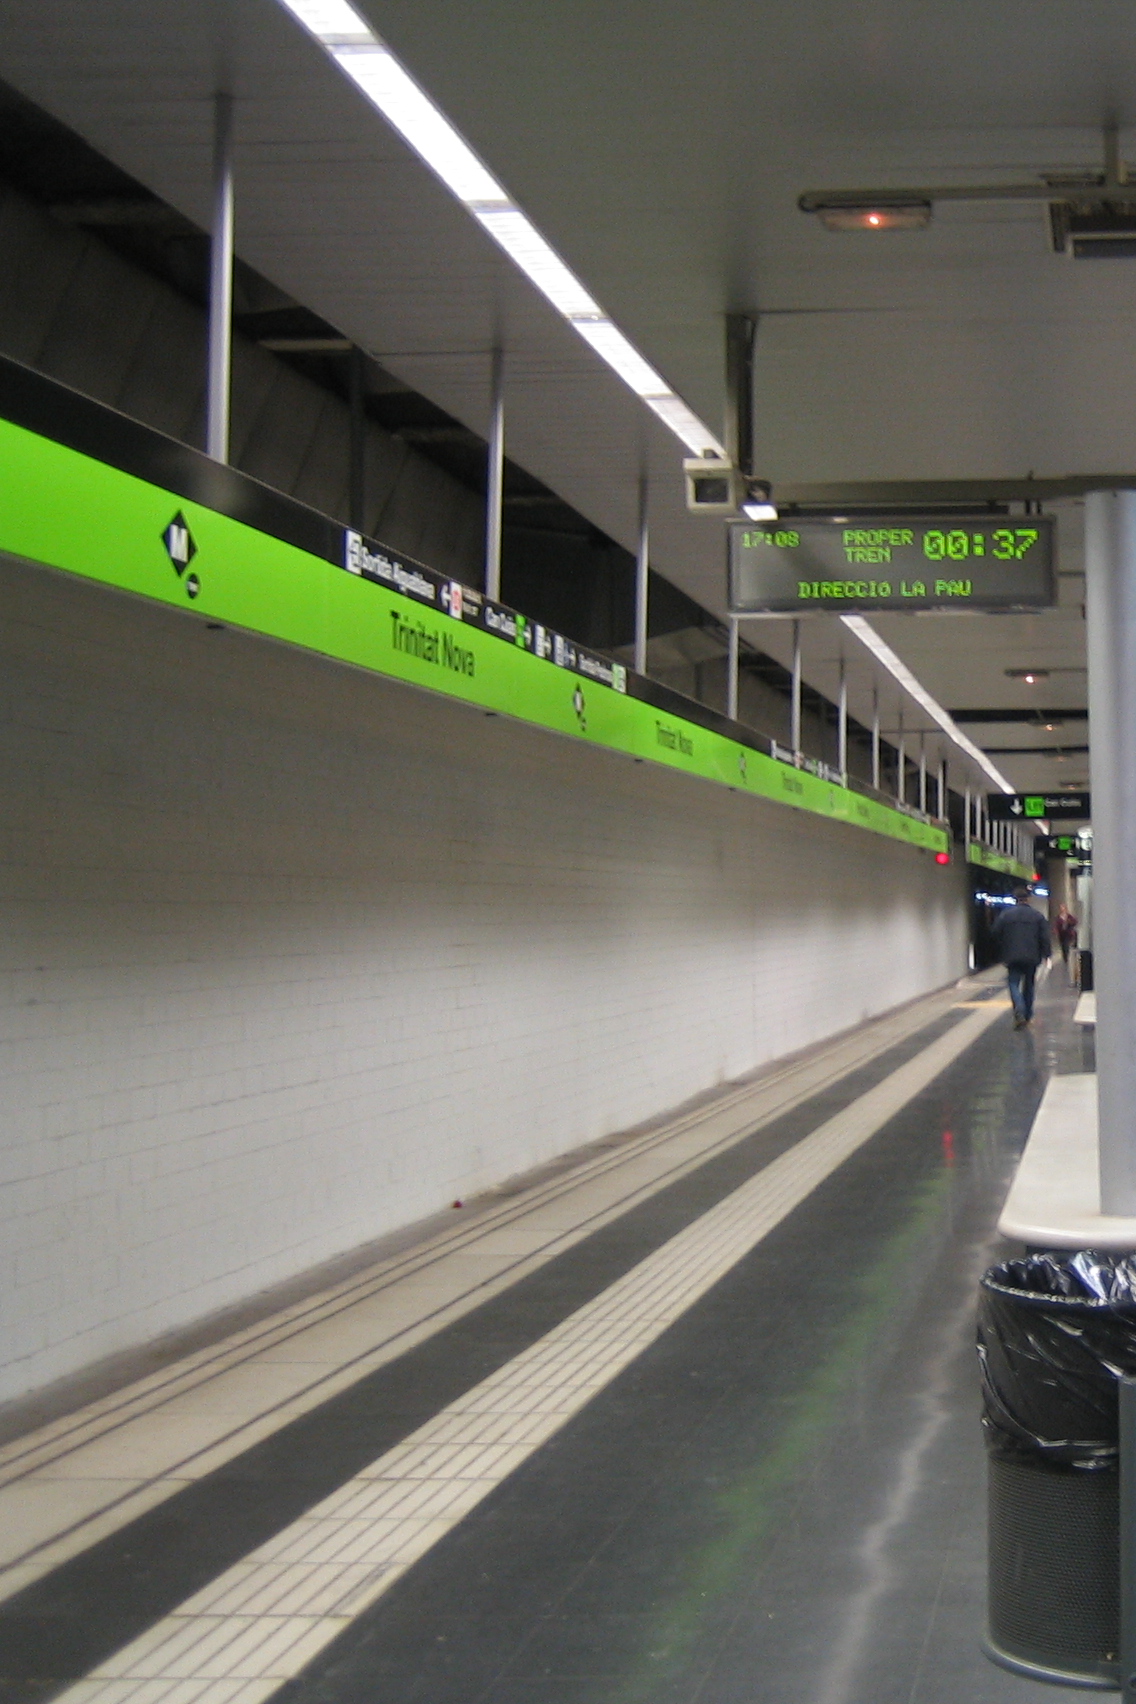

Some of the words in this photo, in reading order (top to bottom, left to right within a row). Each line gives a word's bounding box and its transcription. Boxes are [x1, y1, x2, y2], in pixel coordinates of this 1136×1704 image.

[741, 531, 800, 548] 17:08
[842, 529, 914, 546] PROPER
[923, 529, 1039, 560] 00:37
[843, 547, 892, 564] TREN
[901, 580, 926, 597] LA
[935, 579, 972, 597] PAU
[390, 609, 439, 665] Trinitat
[442, 631, 475, 677] Nova
